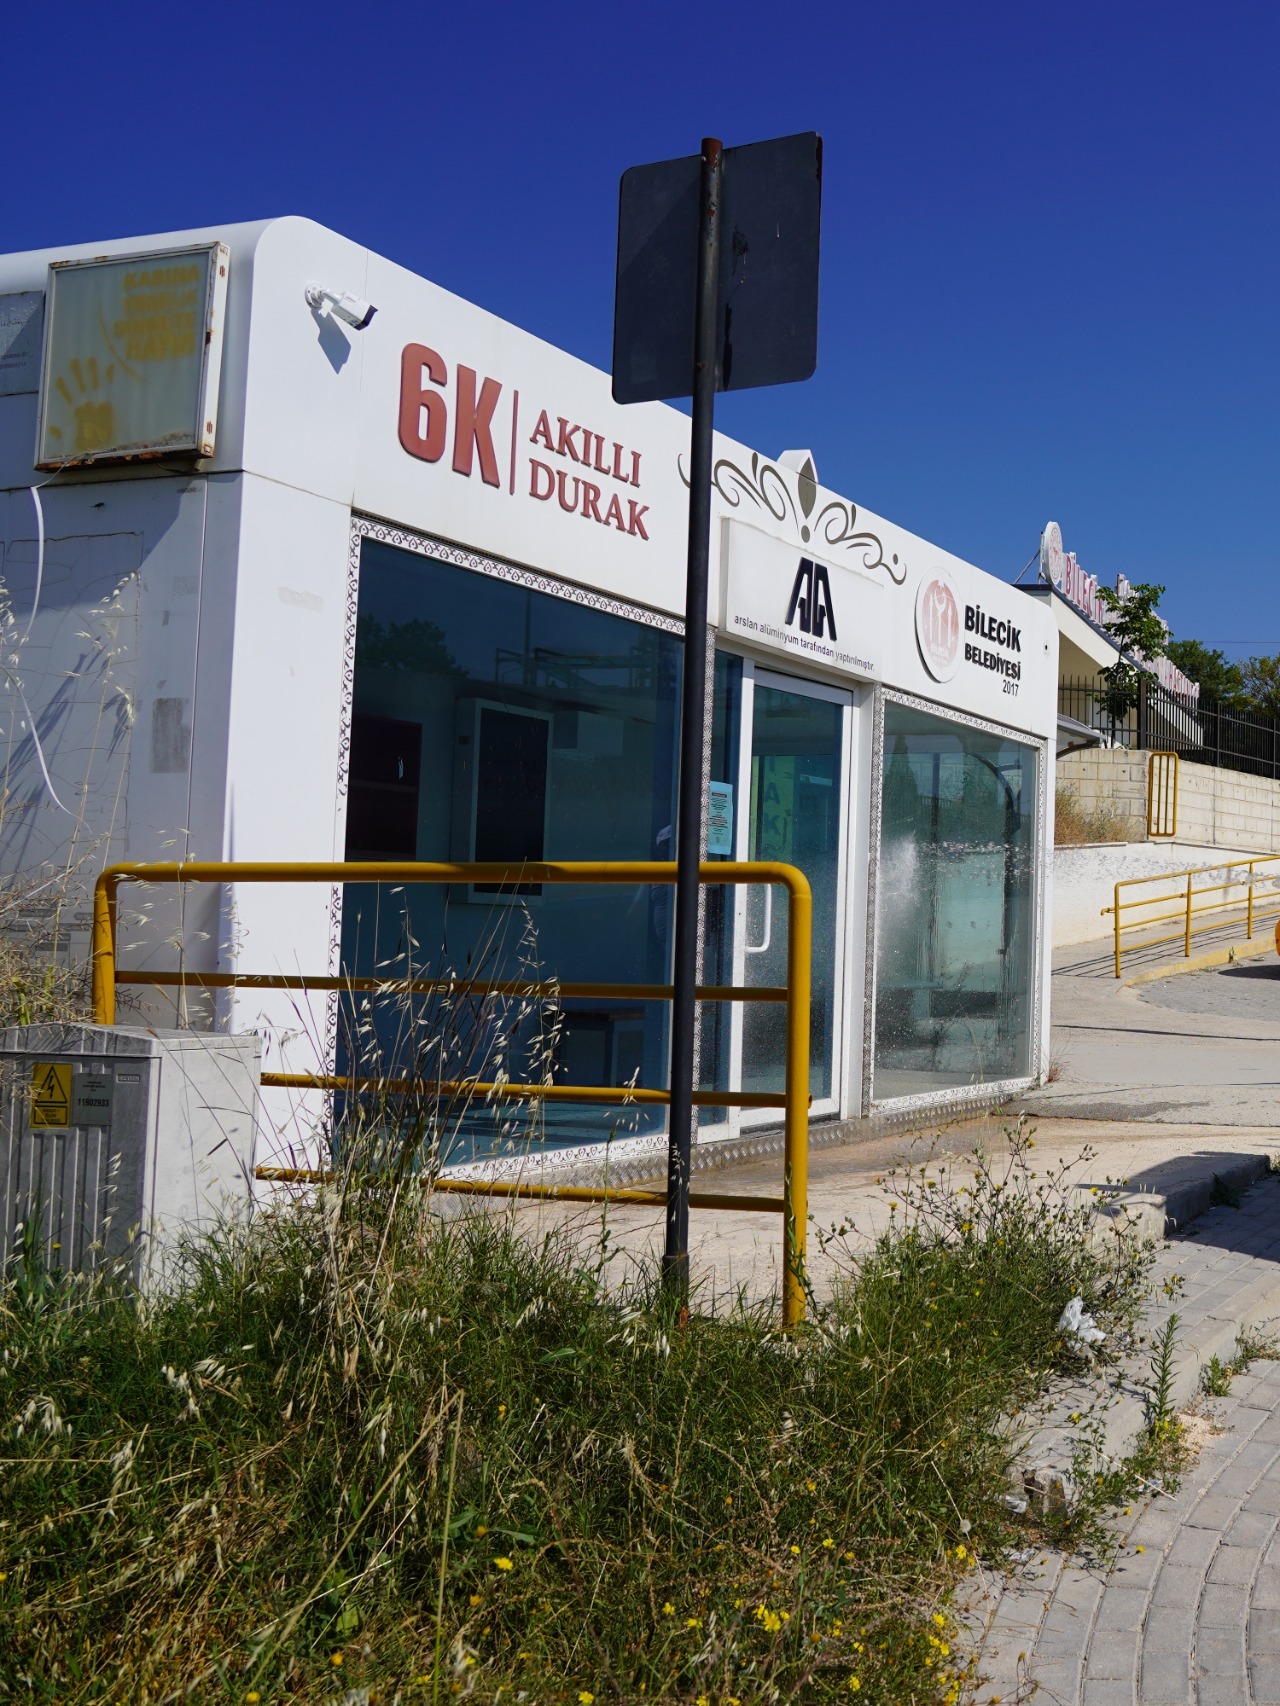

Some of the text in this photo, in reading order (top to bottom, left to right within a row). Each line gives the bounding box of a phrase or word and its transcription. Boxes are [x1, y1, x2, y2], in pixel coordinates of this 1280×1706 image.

[398, 343, 503, 489] 6K
[529, 409, 642, 487] AKILLI
[529, 458, 650, 541] DURAK
[734, 615, 758, 631] arslan
[760, 624, 799, 645] alüminyum
[800, 637, 834, 657] tarafından
[965, 604, 1021, 653] BİLECİK
[965, 643, 1021, 681] BELEDİYESİ
[1002, 679, 1019, 697] 2017
